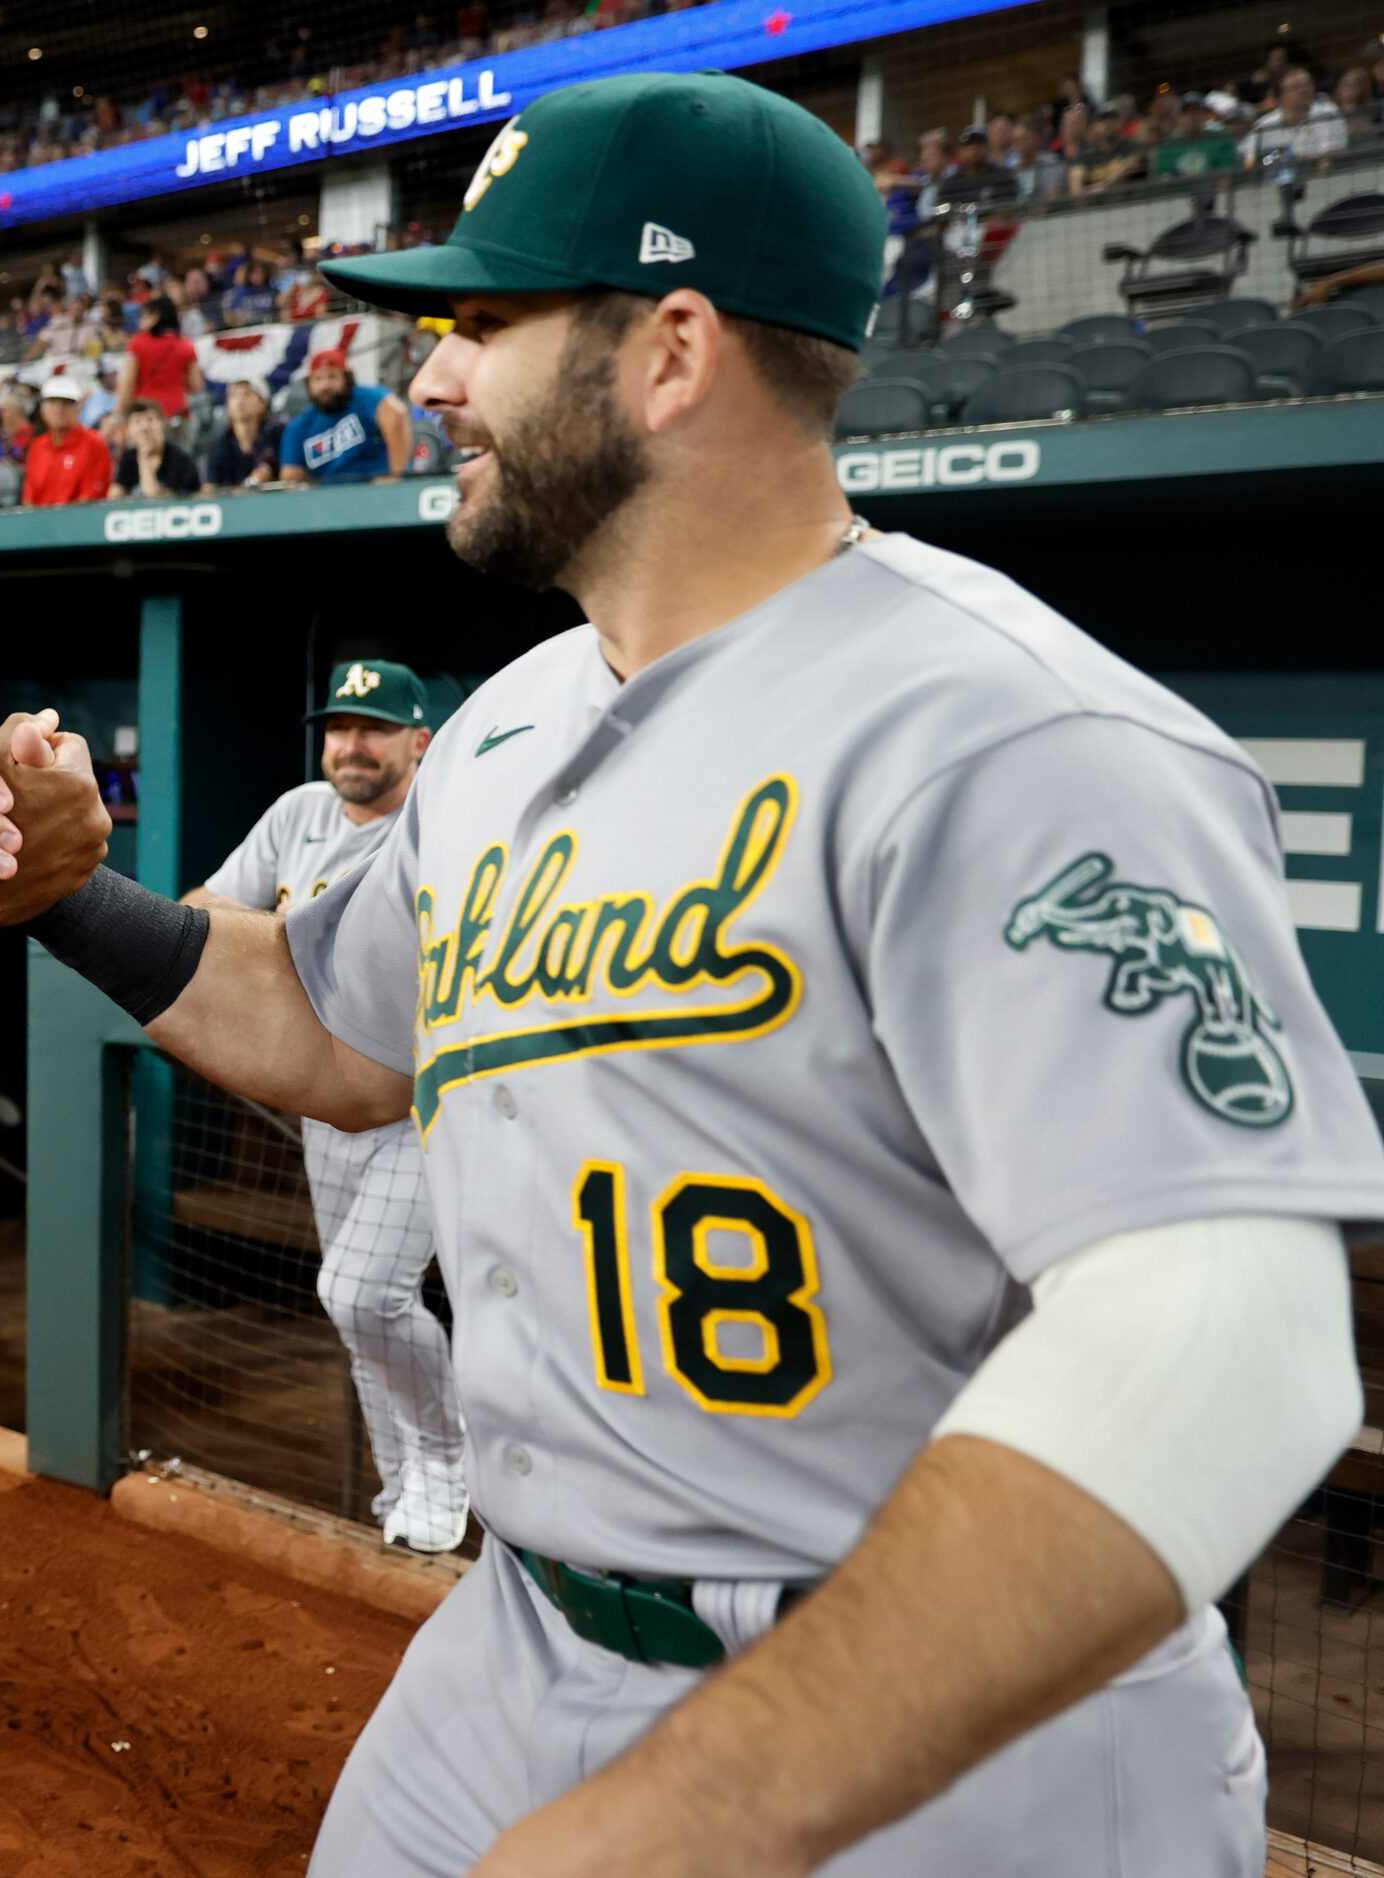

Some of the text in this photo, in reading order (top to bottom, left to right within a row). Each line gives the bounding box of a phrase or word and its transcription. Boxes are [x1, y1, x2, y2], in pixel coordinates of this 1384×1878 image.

[176, 70, 512, 178] JEFF RUSSELL
[837, 439, 1041, 492] GEICO
[103, 504, 222, 542] GEICO
[571, 1158, 833, 1419] 18
